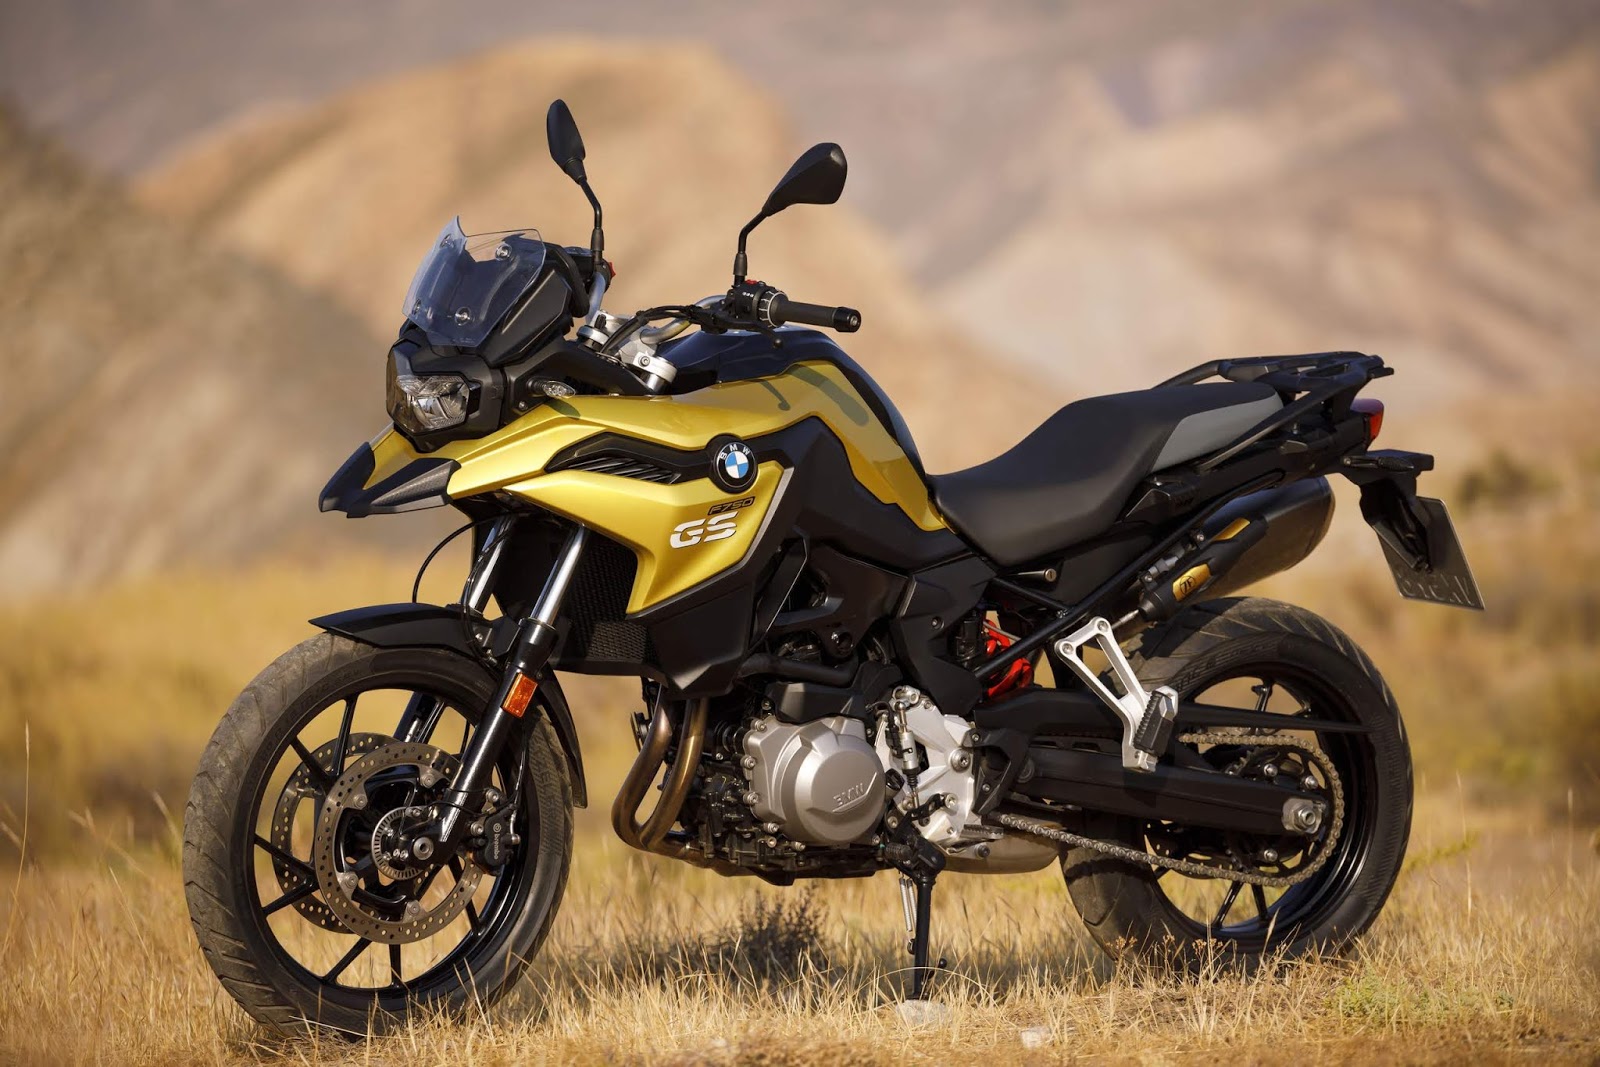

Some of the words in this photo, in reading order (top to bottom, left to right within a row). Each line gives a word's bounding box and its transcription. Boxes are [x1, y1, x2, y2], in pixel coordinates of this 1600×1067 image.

[719, 443, 750, 460] BMW
[709, 497, 754, 515] F750
[669, 511, 738, 549] GS
[493, 833, 501, 860] brembo
